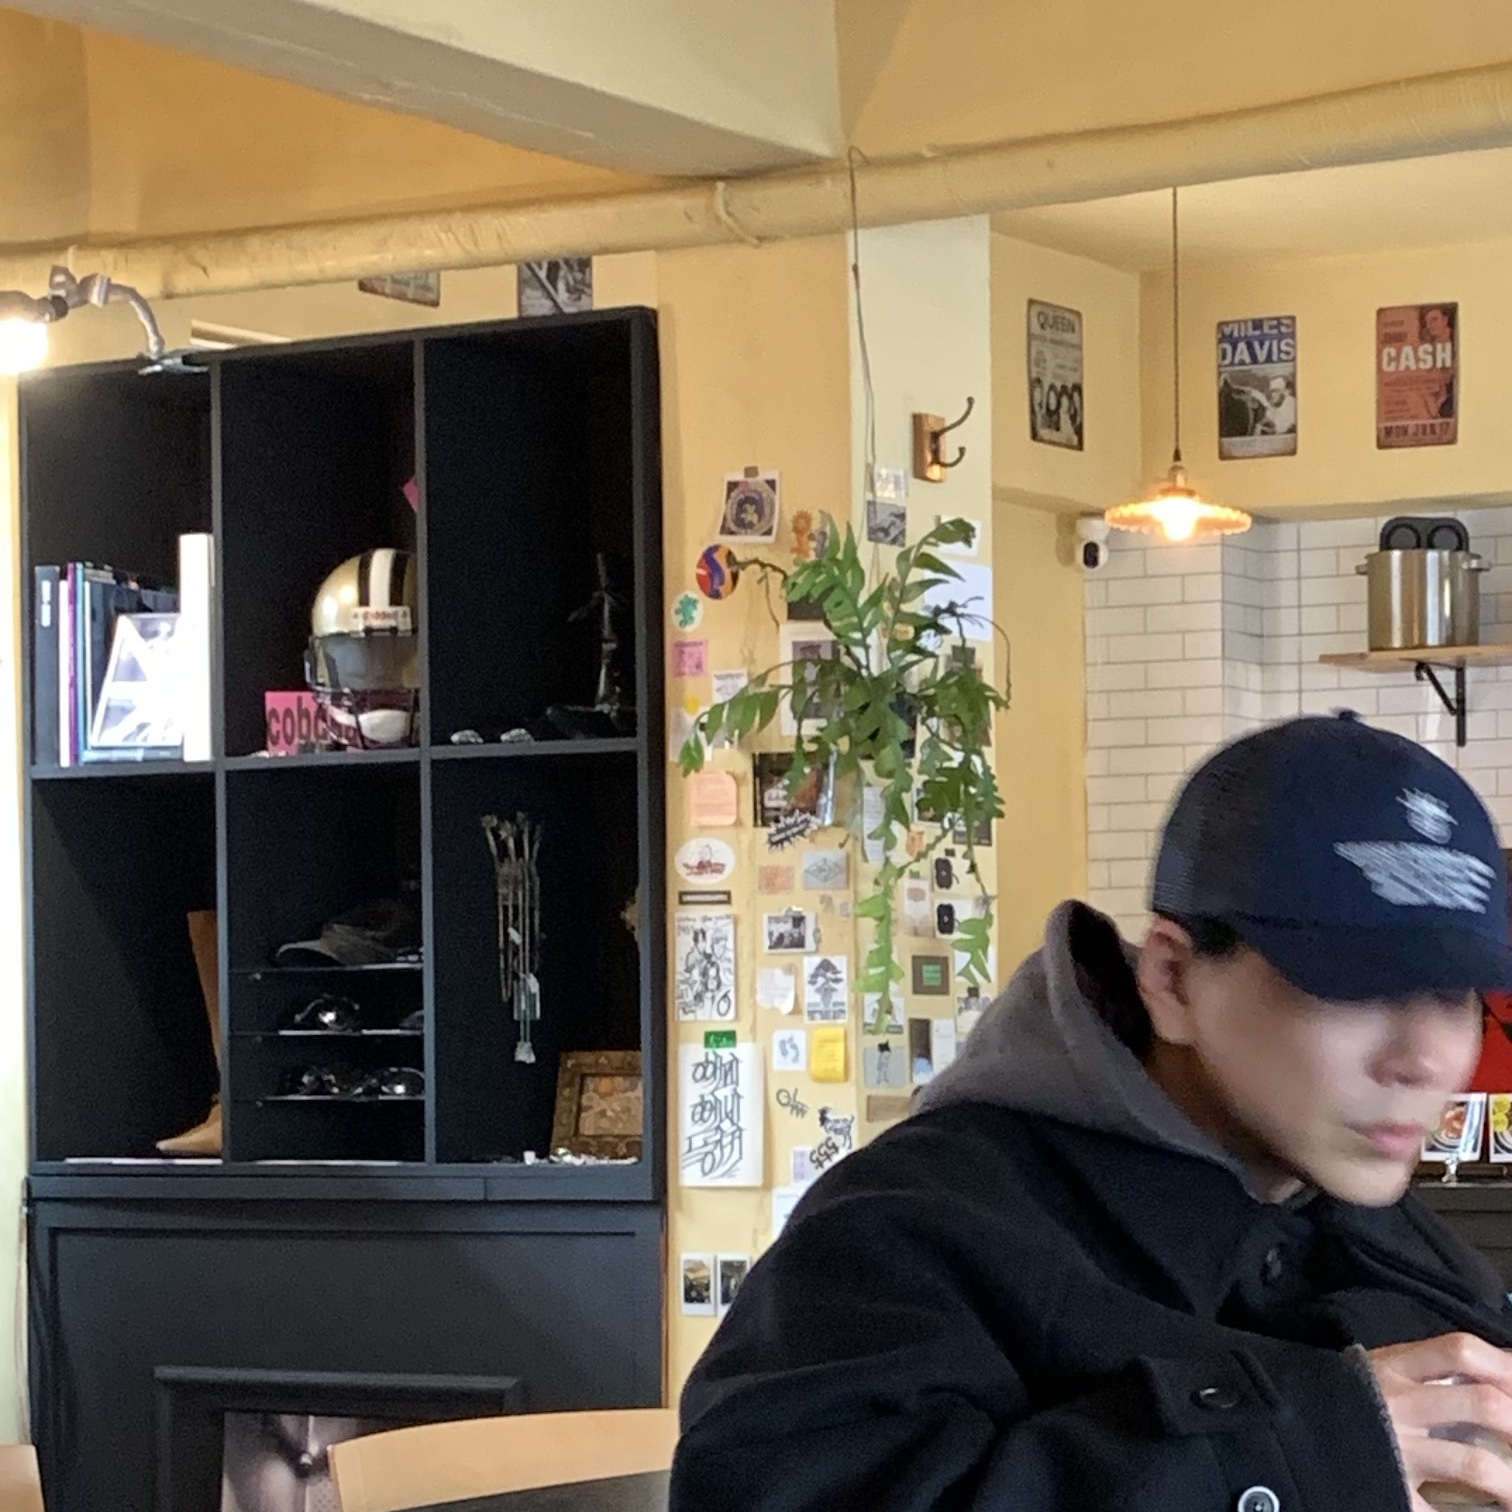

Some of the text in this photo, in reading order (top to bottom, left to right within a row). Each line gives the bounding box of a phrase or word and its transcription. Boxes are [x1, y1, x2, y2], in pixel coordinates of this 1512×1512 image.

[1036, 309, 1076, 335] QUEEN
[1218, 317, 1294, 339] MILES
[1219, 338, 1296, 367] DAVIS
[1382, 341, 1453, 372] CASH
